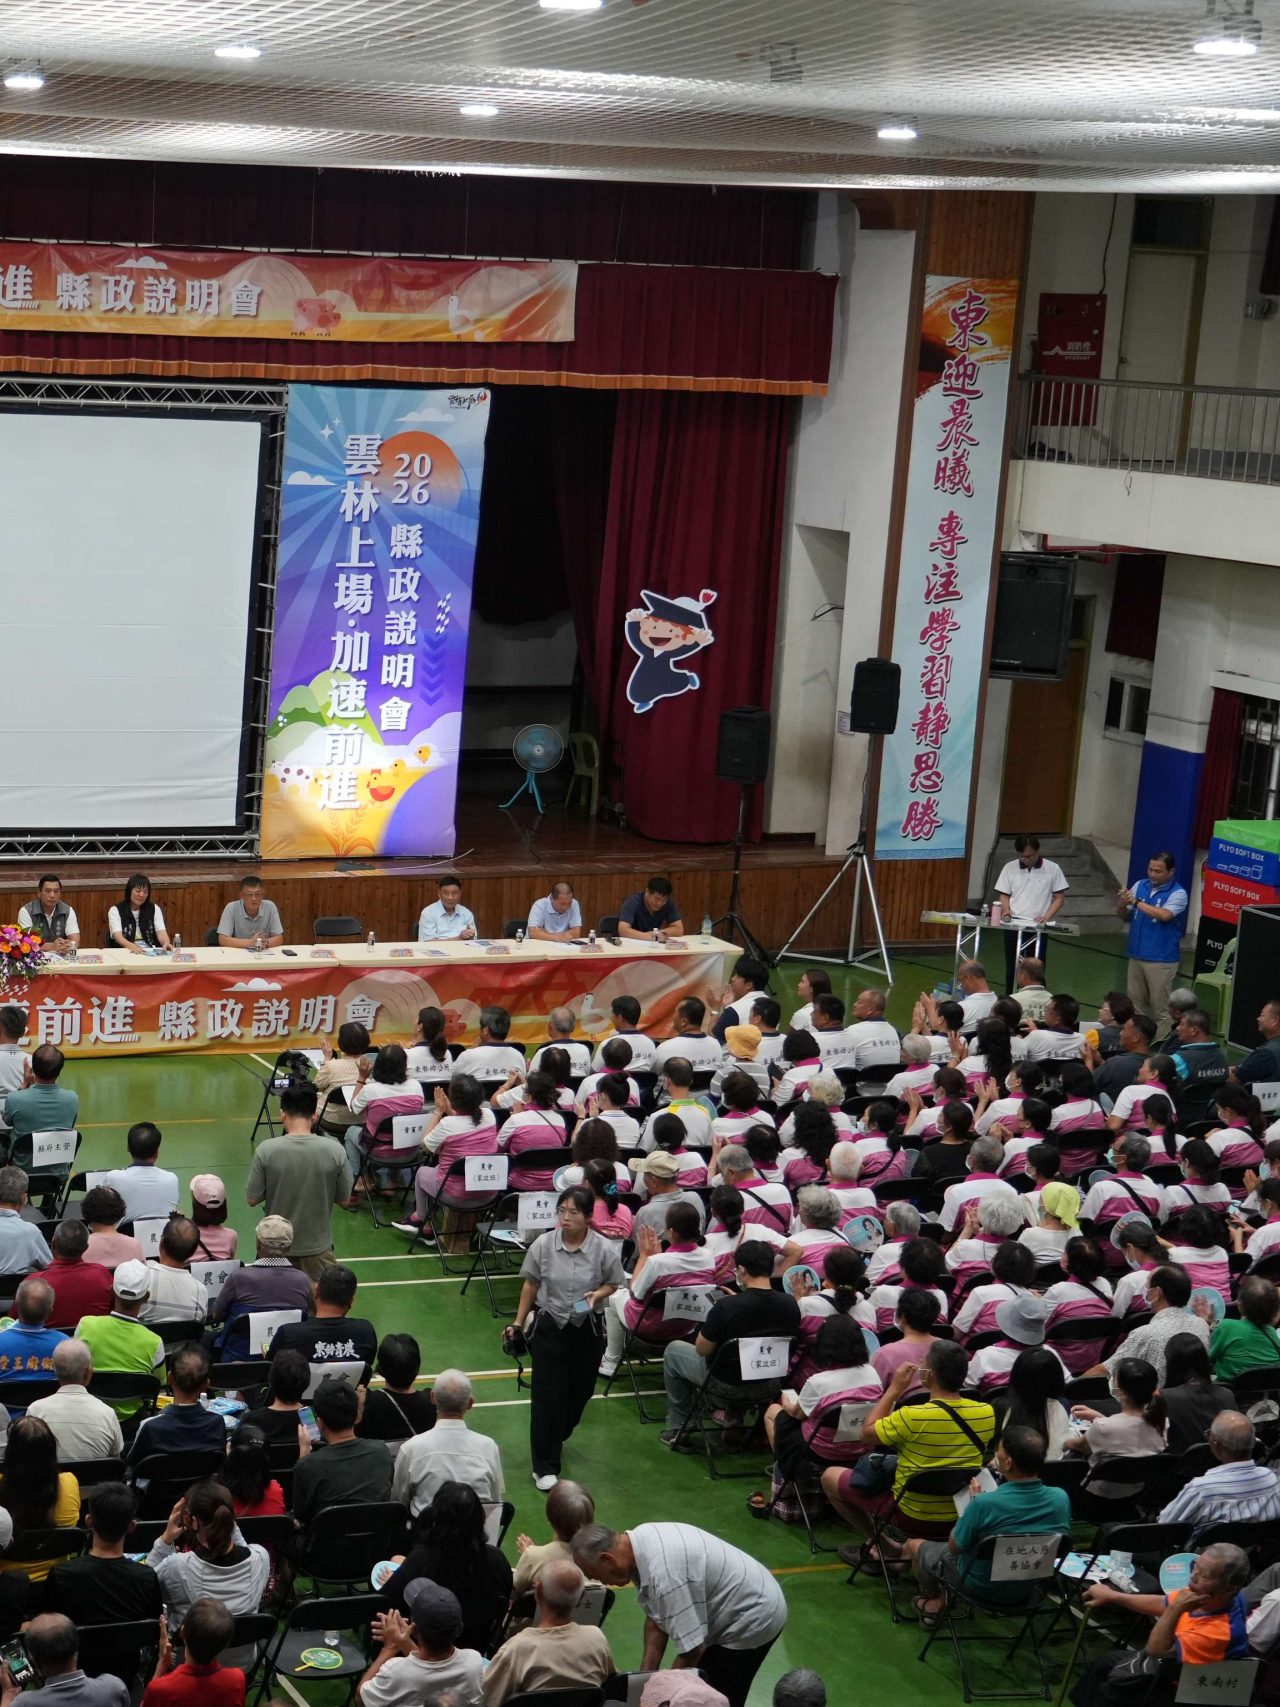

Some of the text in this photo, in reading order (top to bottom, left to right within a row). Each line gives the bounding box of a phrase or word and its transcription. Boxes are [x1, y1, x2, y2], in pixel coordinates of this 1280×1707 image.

[1218, 843, 1265, 862] PLYO SOFT BOX
[1213, 881, 1261, 901] PLYO SOFT BOX
[1207, 939, 1223, 950] PLYO
[204, 1270, 228, 1286] 農會
